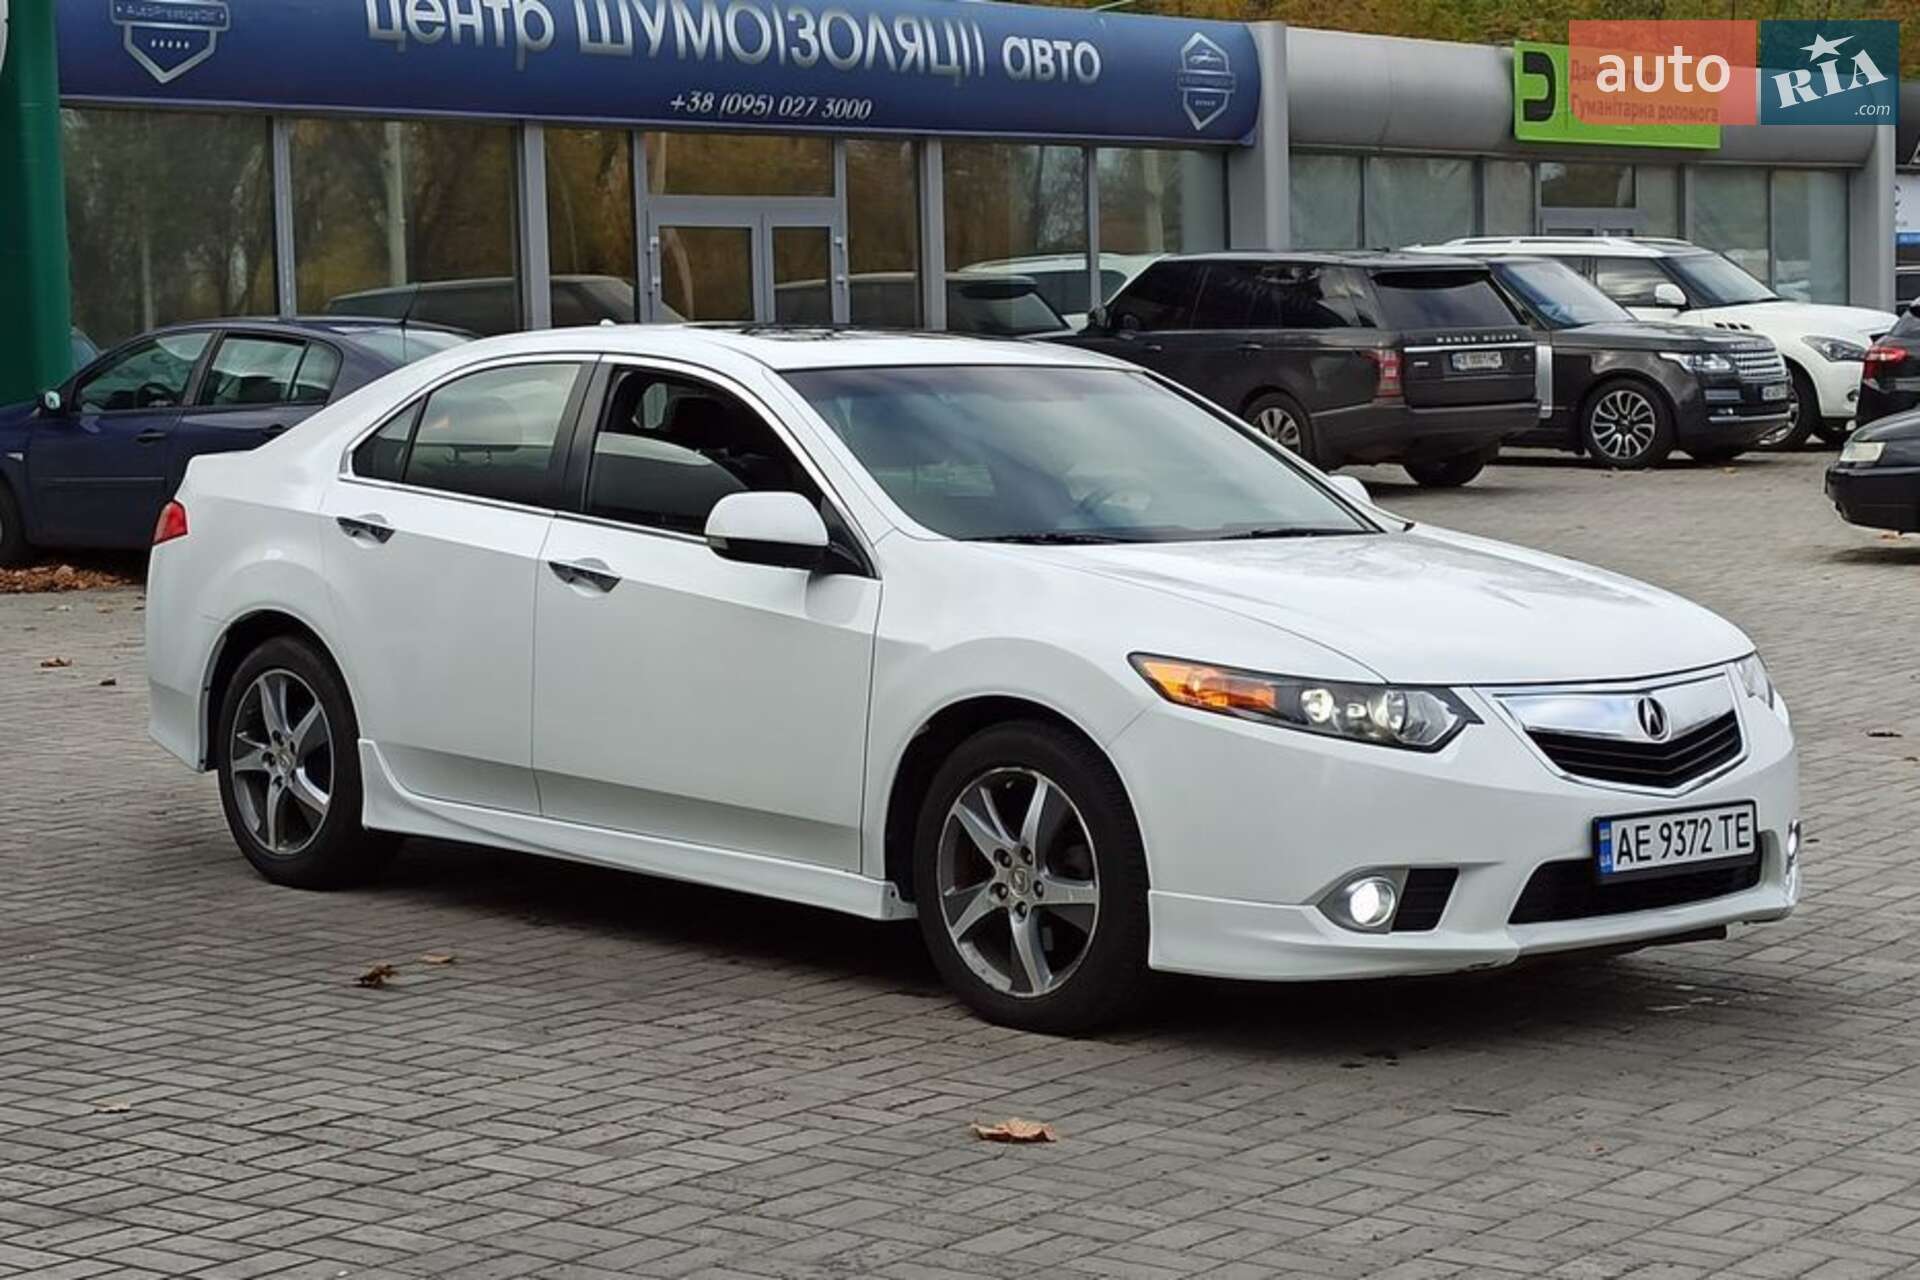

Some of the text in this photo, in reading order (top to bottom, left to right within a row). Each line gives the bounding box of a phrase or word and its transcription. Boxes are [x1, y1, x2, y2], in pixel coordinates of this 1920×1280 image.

[1002, 35, 1101, 84] авто
[670, 90, 872, 120] +38 (095) 027 3000
[1616, 824, 1653, 865] AE
[1658, 816, 1713, 860] 9372
[1718, 811, 1751, 851] TE
